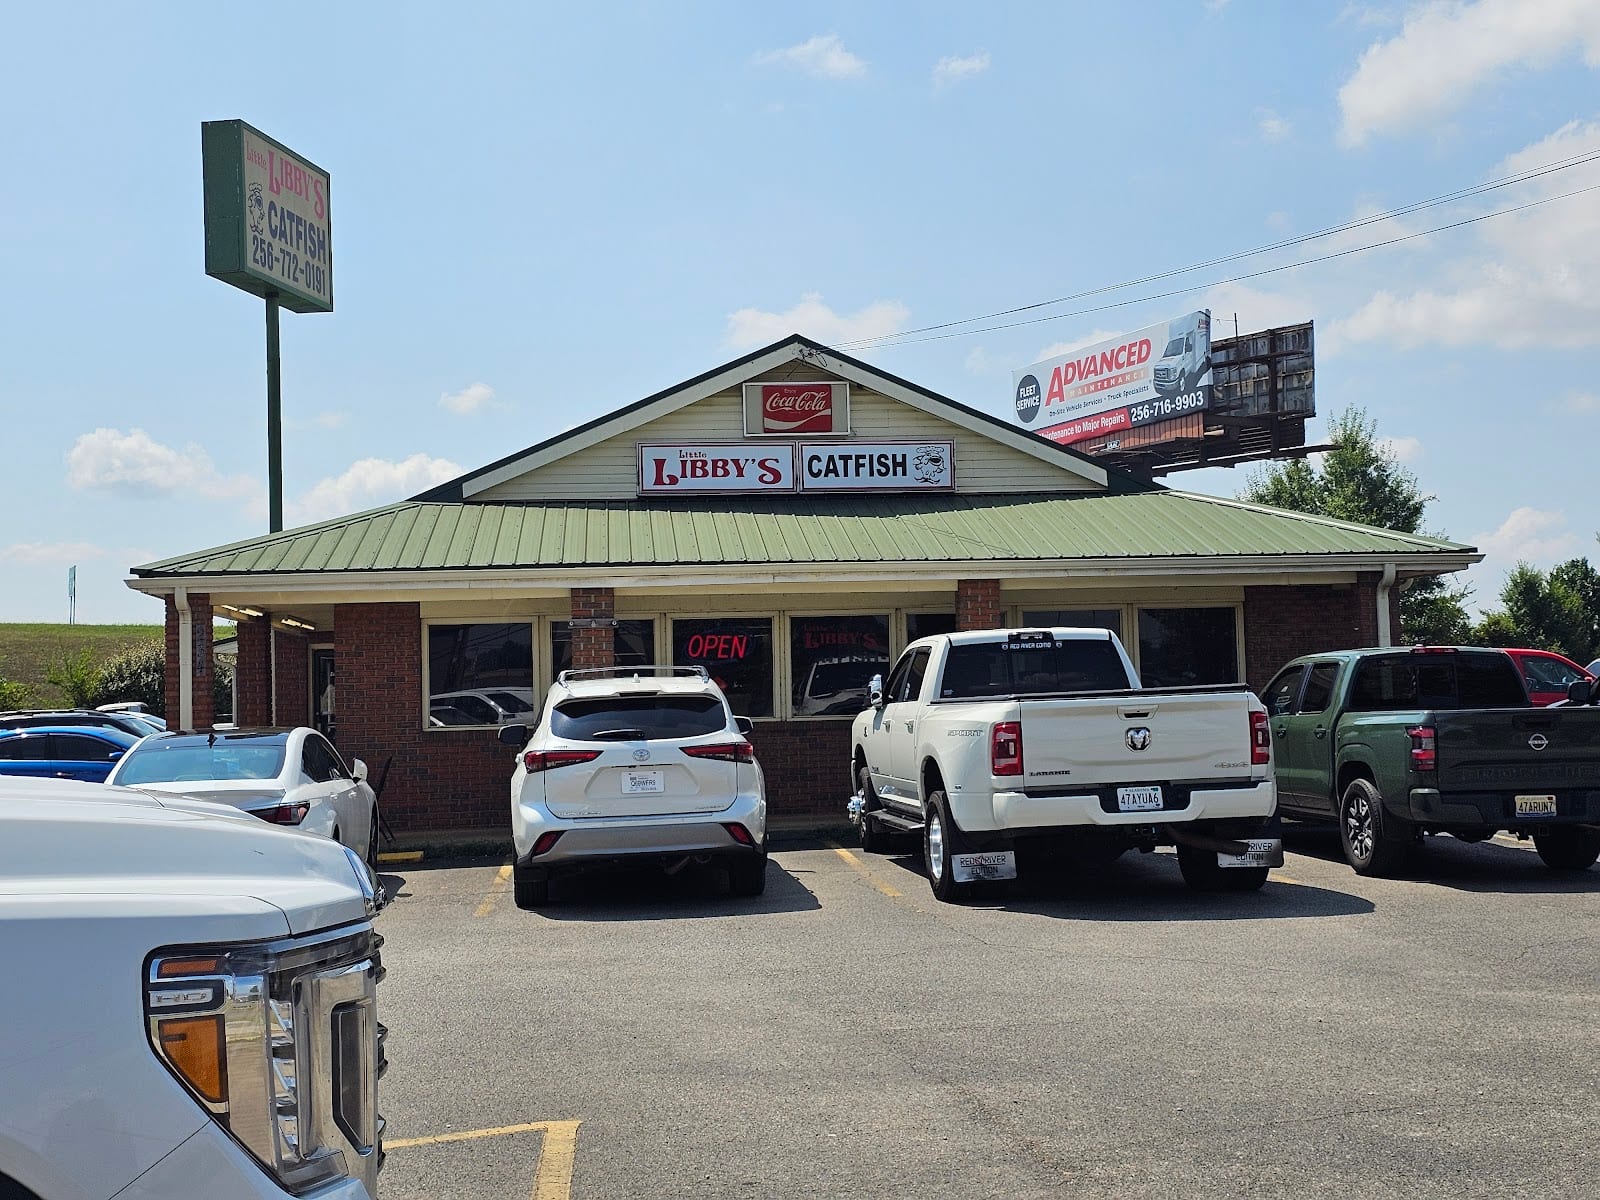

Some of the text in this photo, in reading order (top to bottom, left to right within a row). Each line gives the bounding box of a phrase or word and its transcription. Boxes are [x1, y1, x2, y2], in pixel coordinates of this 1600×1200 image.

[246, 141, 267, 170] Little
[268, 200, 326, 265] CATFISH
[252, 234, 326, 296] 256-772-0191
[1045, 338, 1152, 407] ADVANCED
[1069, 370, 1145, 397] MAINTENANCE
[1016, 395, 1040, 411] SERVICE
[1020, 384, 1036, 398] FLEET
[1065, 402, 1083, 412] Vehicle
[1083, 397, 1103, 408] Services
[1107, 393, 1122, 401] Truck
[1122, 385, 1150, 398] Specialists
[1130, 391, 1204, 422] 256-716-9903
[1074, 423, 1082, 433] to
[1082, 418, 1100, 433] Major
[1100, 412, 1125, 429] Repairs
[679, 450, 707, 458] Little
[807, 453, 908, 478] CATFISH
[652, 458, 782, 485] LIBBY'S
[688, 634, 747, 659] OPEN
[1120, 792, 1159, 805] 47AYUA6
[1250, 842, 1273, 851] RIVER
[960, 854, 1006, 866] RED RIVER
